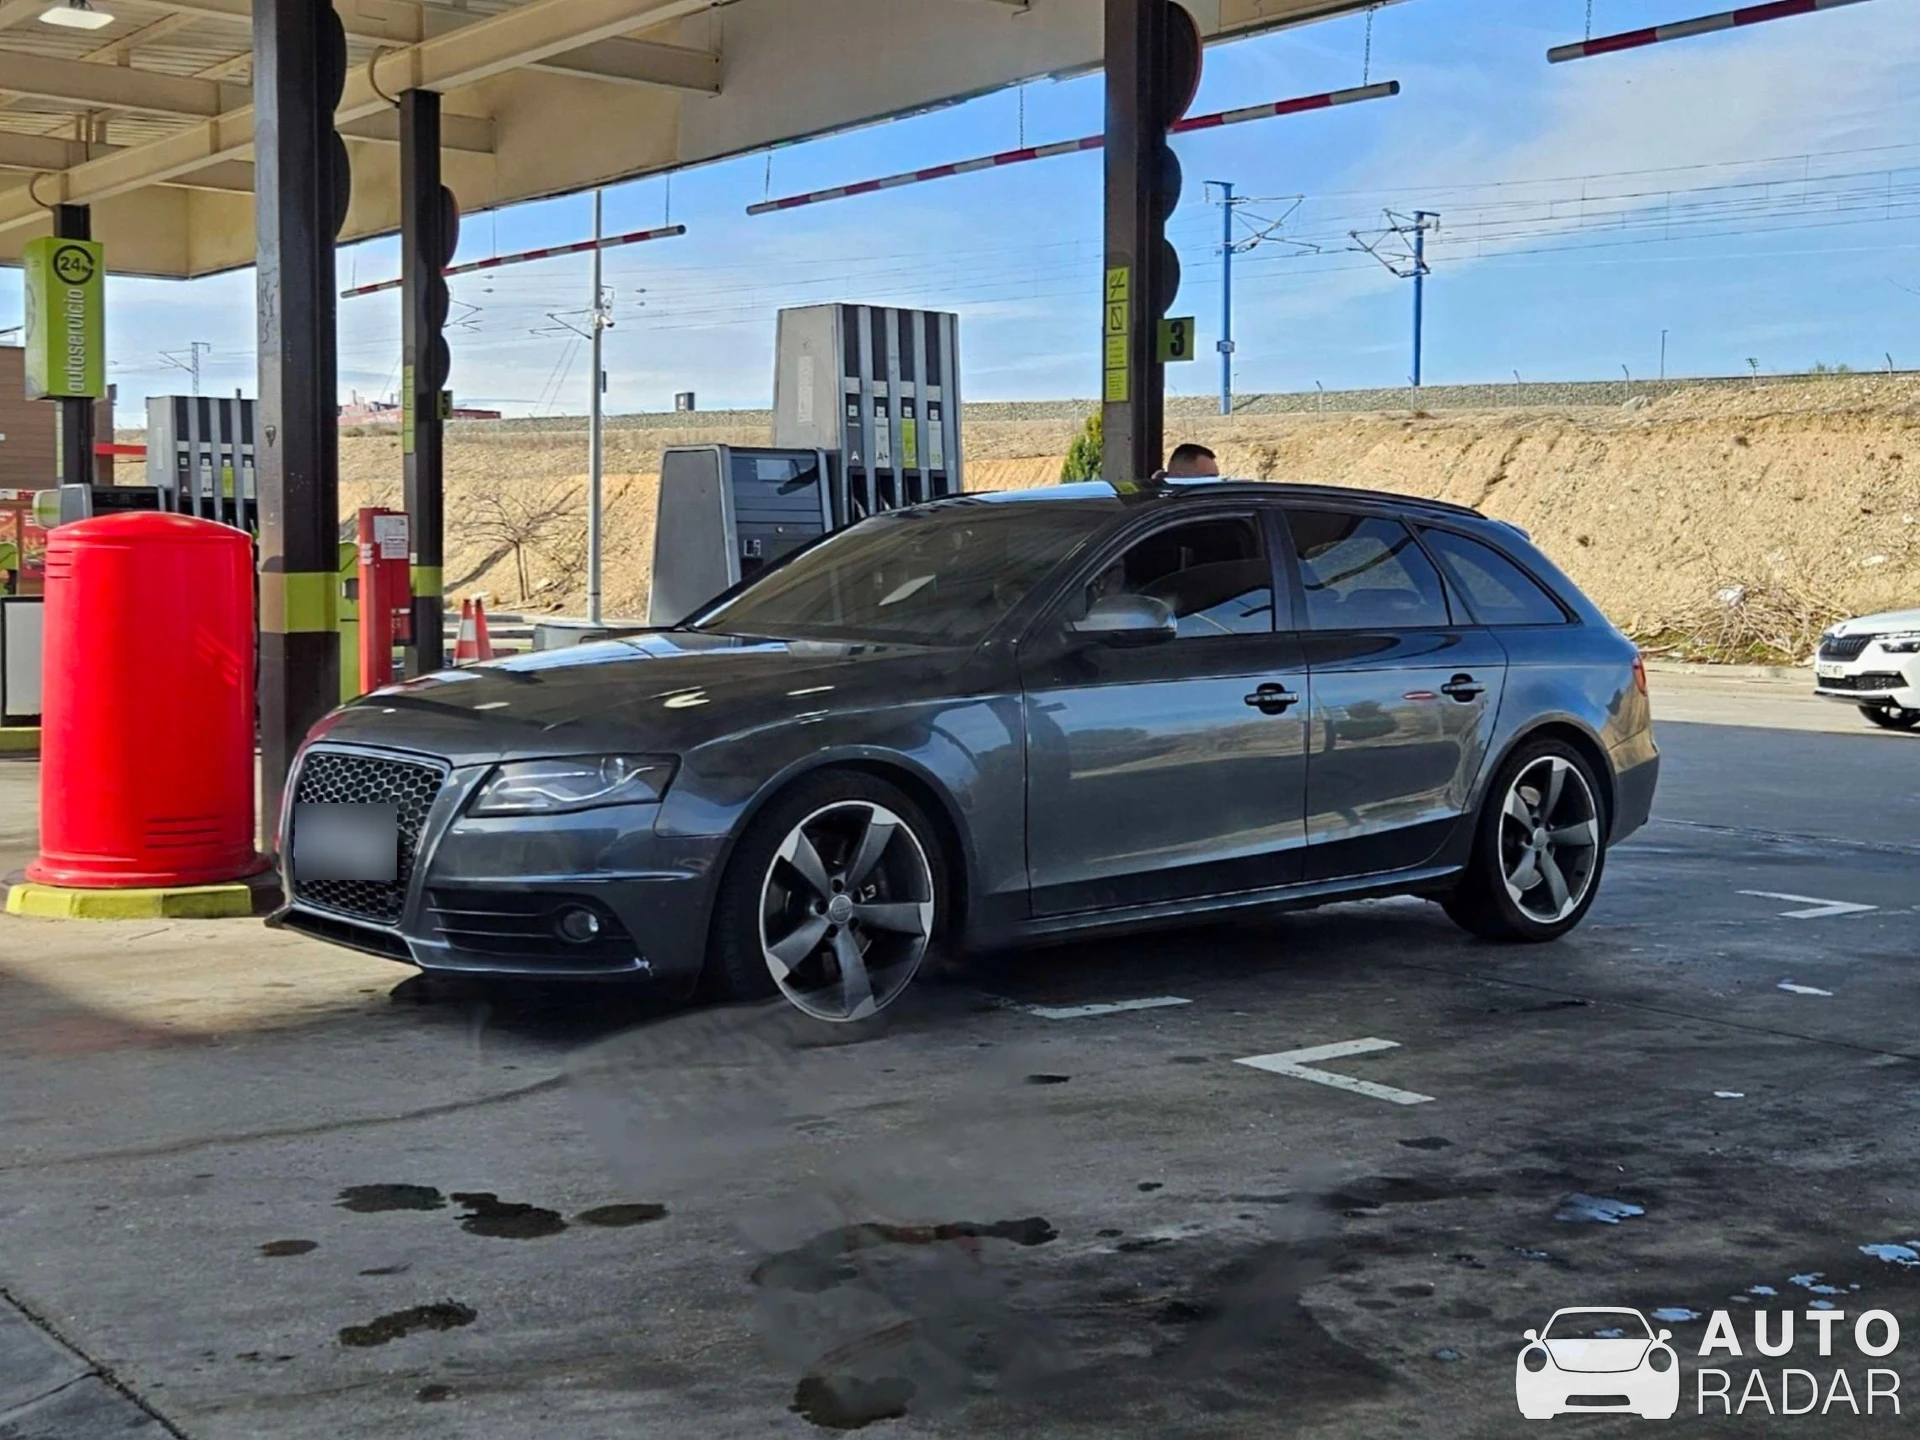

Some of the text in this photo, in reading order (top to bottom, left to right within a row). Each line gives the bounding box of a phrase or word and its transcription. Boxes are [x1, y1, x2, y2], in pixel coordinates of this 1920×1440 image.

[64, 289, 85, 392] autoservicio
[1170, 321, 1185, 356] 3
[851, 451, 860, 461] A
